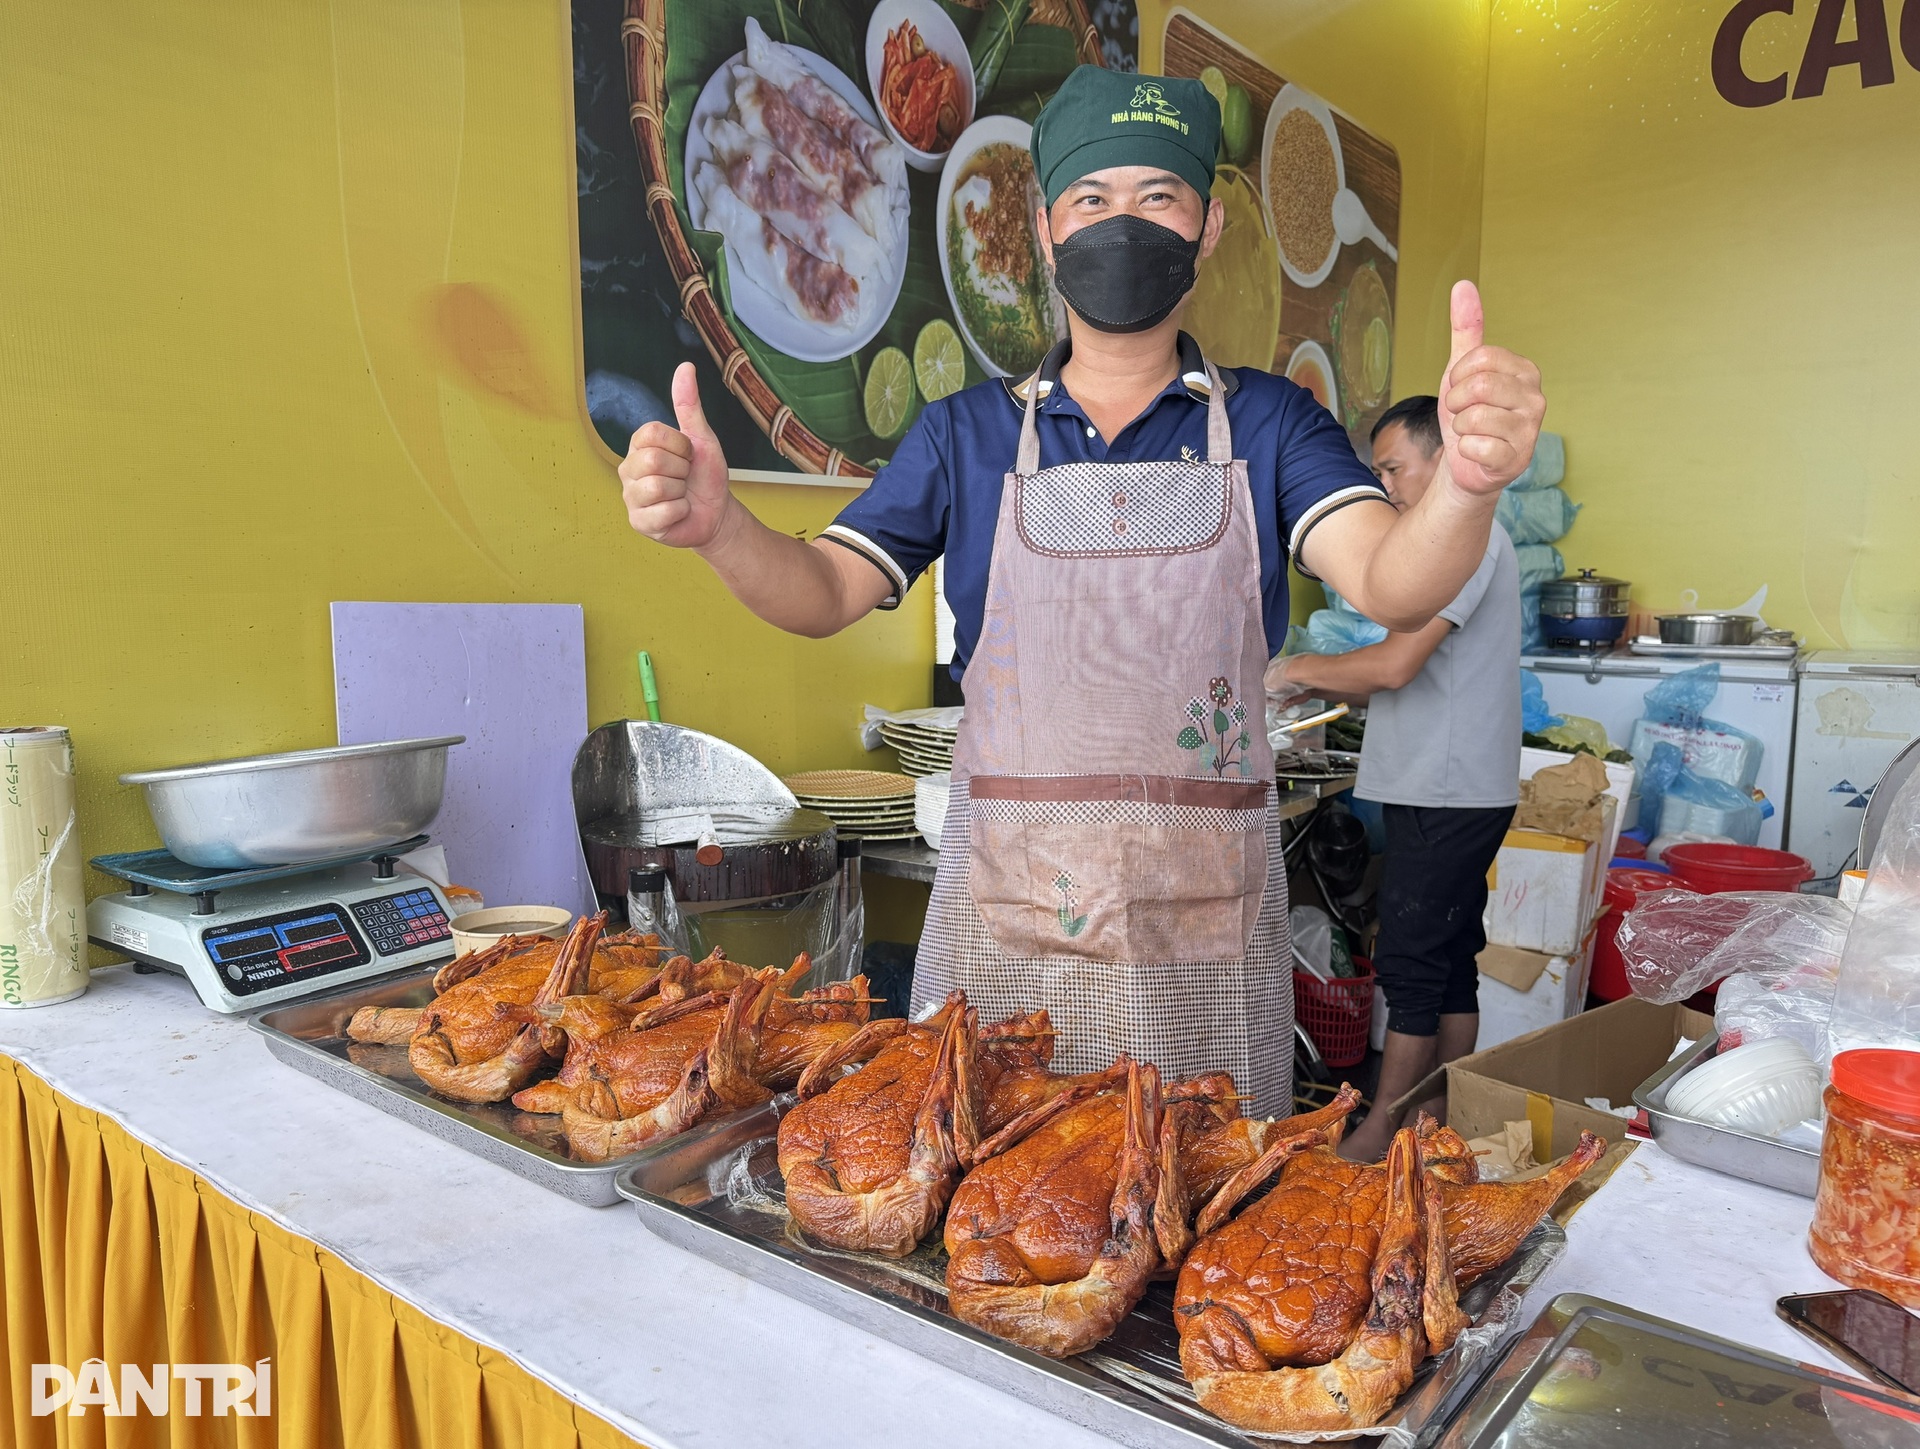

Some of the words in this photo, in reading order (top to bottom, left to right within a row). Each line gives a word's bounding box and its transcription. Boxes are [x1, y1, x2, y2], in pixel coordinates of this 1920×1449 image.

[1711, 0, 1920, 108] CA
[1111, 110, 1129, 124] NHÀ
[1131, 110, 1153, 122] HÀNG
[1155, 113, 1180, 130] PHONG
[4, 737, 22, 808] フードラップ
[0, 944, 22, 1005] RINGO
